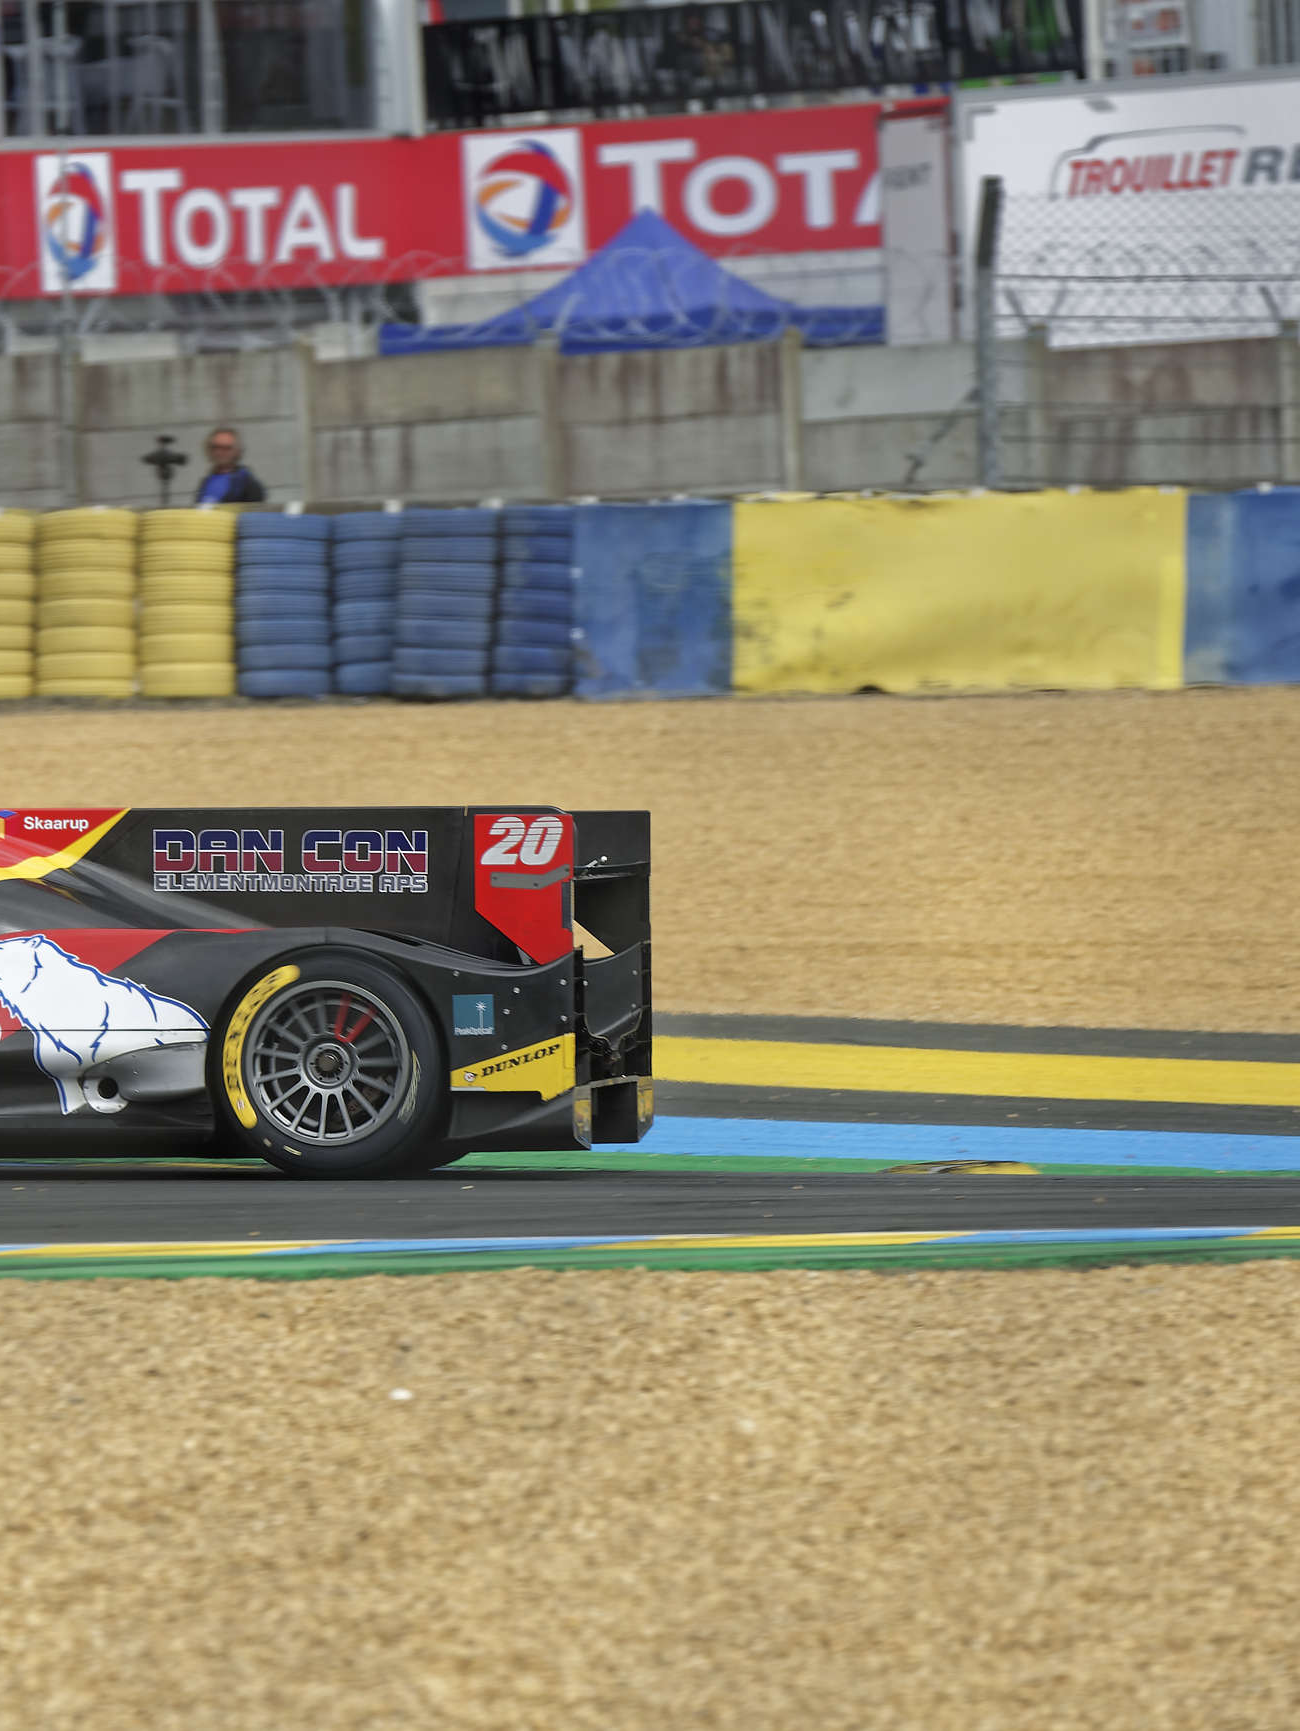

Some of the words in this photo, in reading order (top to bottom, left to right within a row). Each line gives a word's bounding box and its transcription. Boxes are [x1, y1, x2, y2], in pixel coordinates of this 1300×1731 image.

[596, 137, 881, 237] TOT
[120, 168, 385, 268] TOTAL
[23, 815, 89, 832] Skaarup
[480, 815, 565, 867] 20
[153, 829, 285, 873] DAN
[301, 829, 429, 874] CON
[153, 873, 374, 892] ELEMENTMONTAGE
[378, 874, 429, 893] APS
[481, 1044, 560, 1077] DUNLOP
